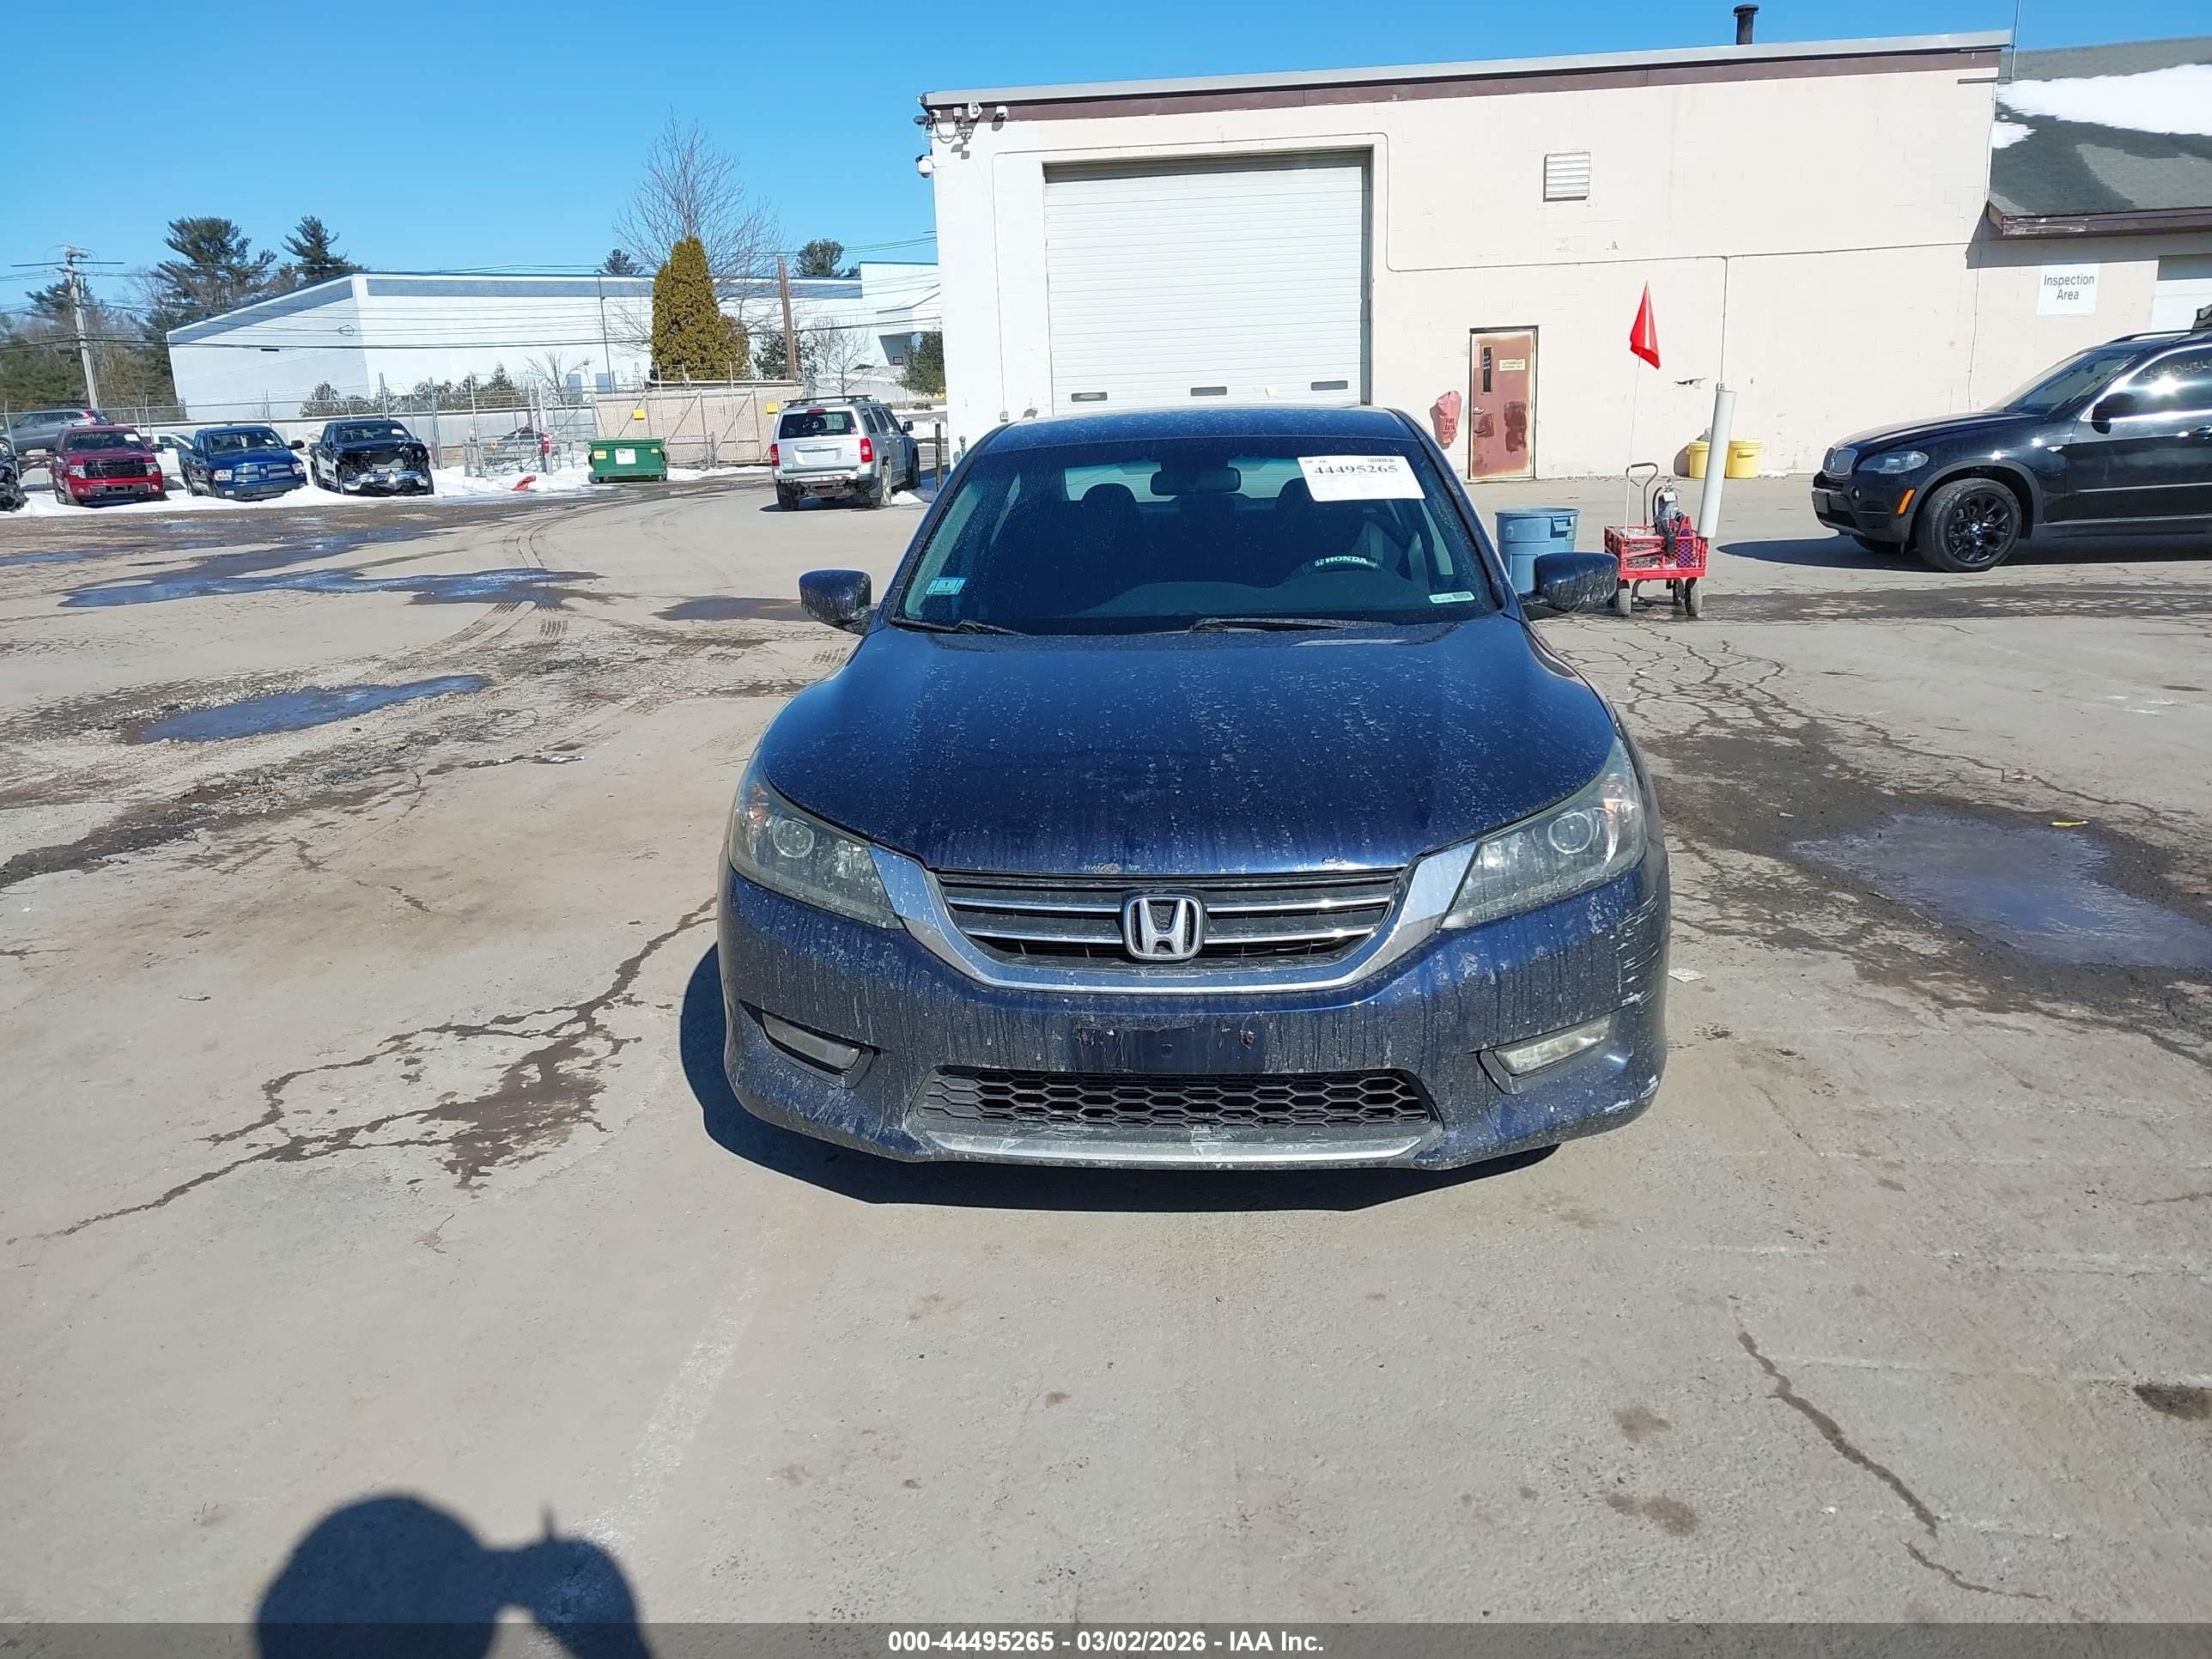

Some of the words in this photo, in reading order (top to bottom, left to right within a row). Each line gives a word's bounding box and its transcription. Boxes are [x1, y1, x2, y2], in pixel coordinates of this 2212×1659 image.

[2044, 273, 2094, 288] Inspection
[2057, 289, 2079, 301] Area
[1314, 465, 1399, 475] 44495265
[1325, 556, 1368, 564] HONDA
